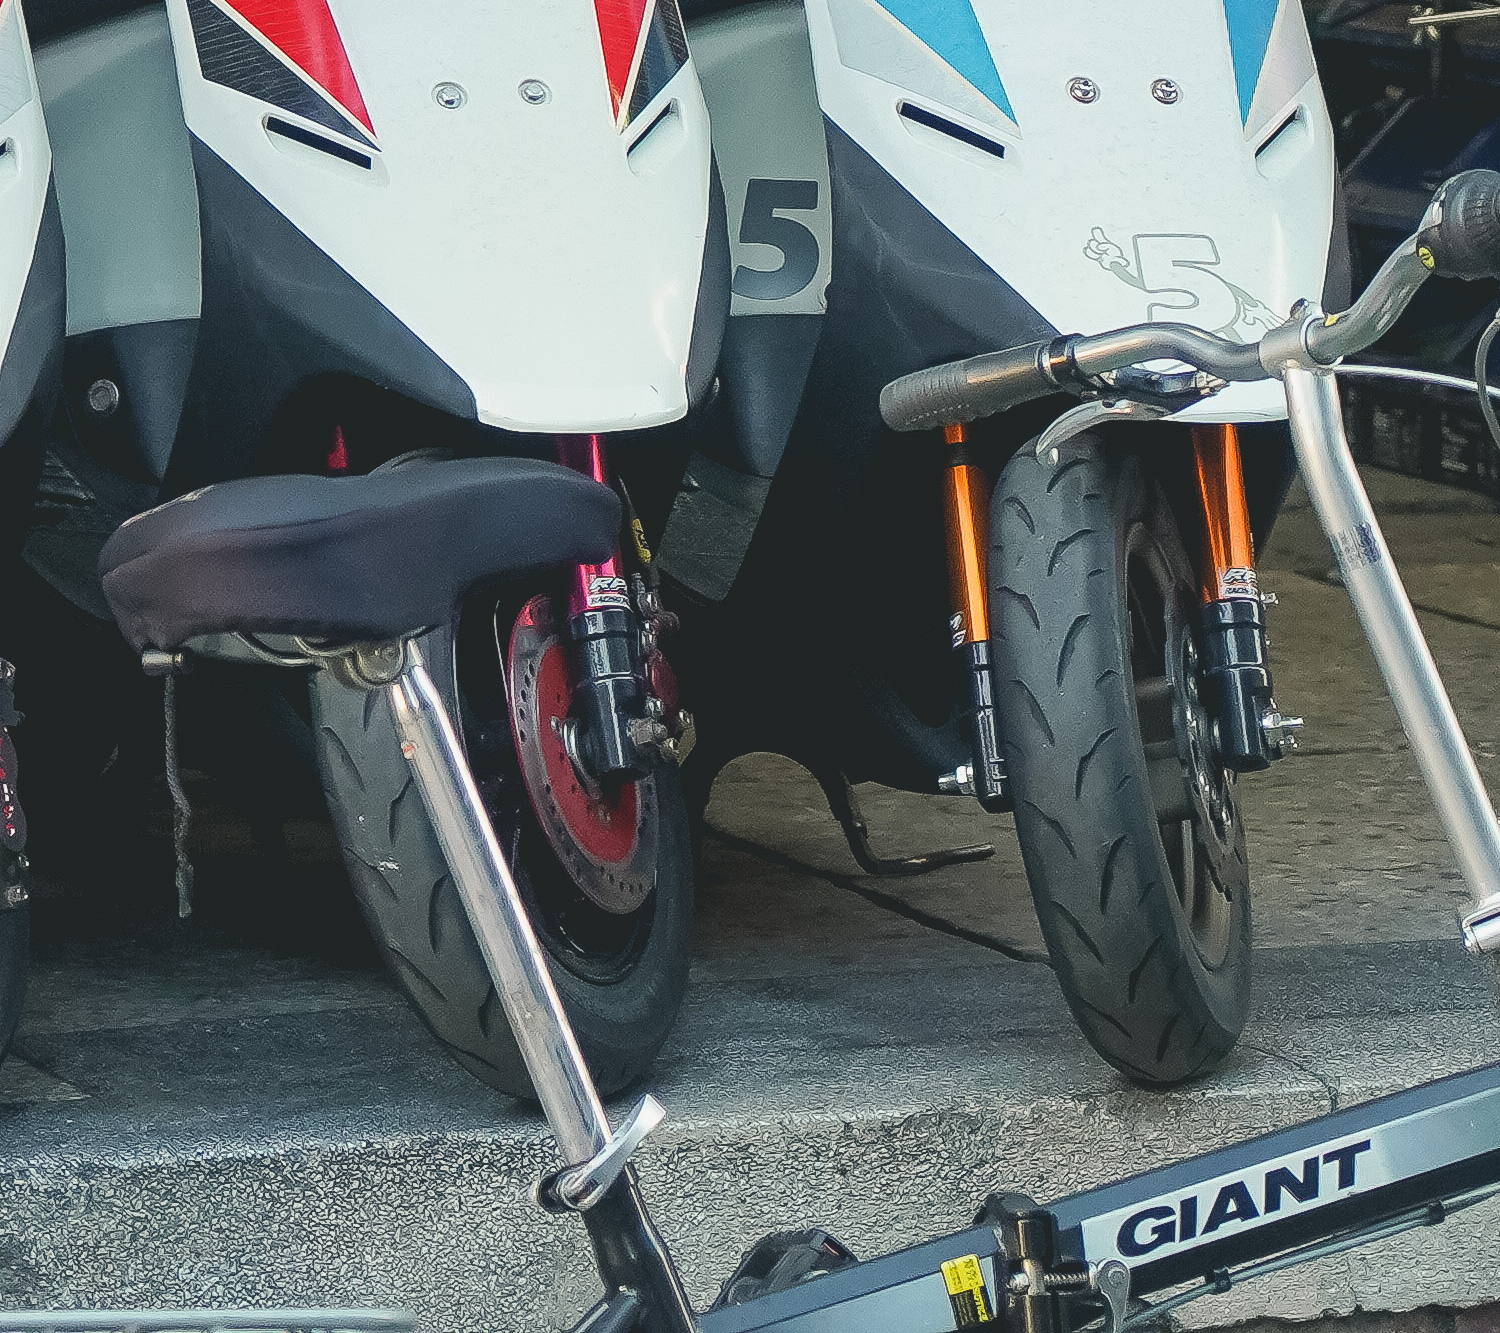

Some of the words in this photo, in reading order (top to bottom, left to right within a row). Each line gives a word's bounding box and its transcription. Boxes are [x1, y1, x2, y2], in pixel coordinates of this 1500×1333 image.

[731, 179, 821, 301] 5
[1131, 233, 1246, 337] 5
[1114, 1138, 1374, 1259] GIANT
